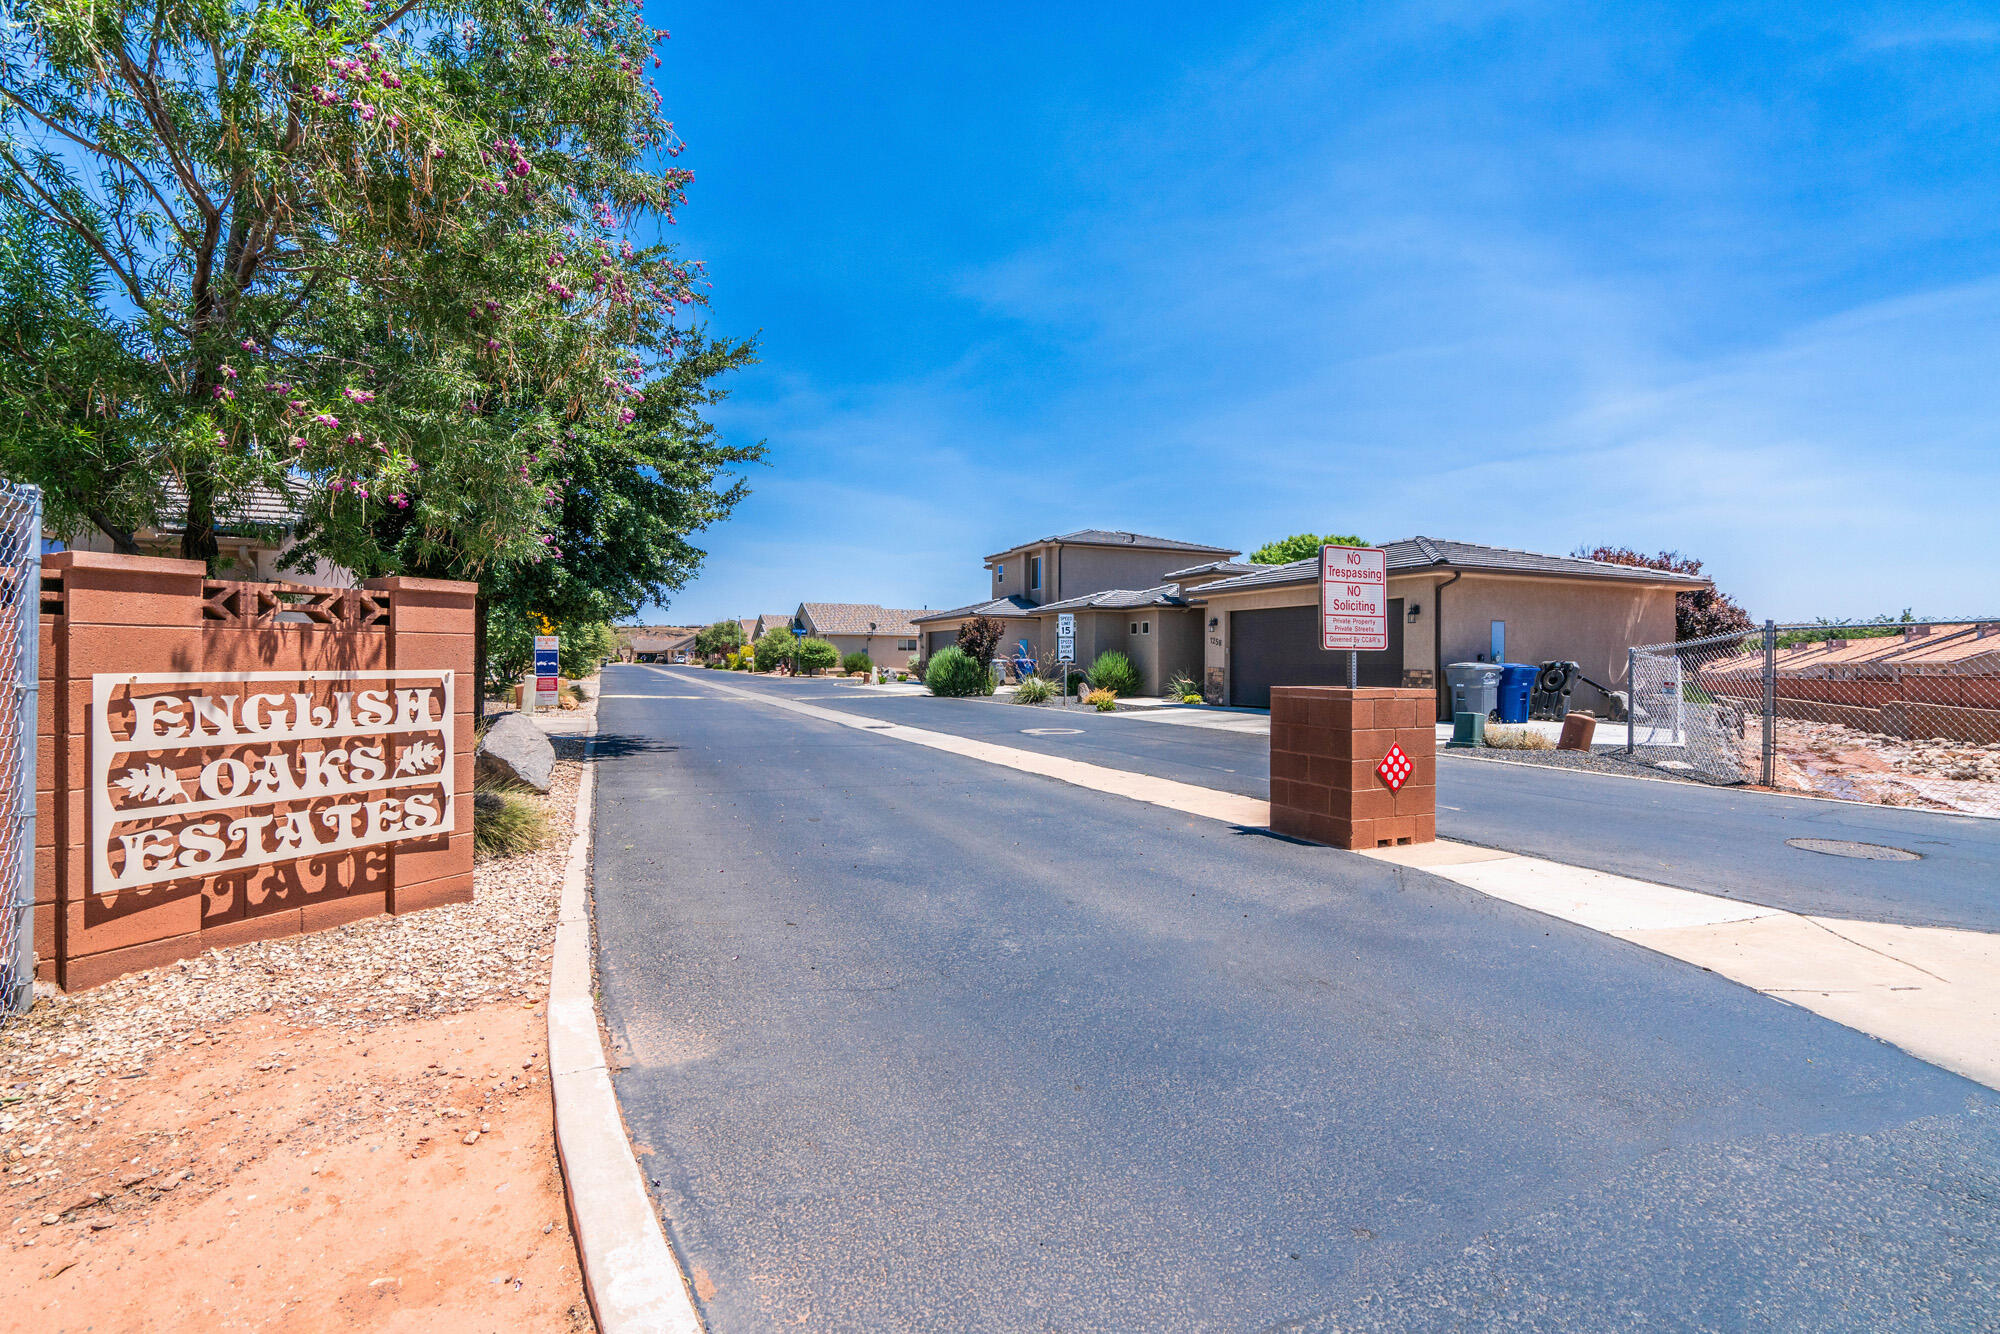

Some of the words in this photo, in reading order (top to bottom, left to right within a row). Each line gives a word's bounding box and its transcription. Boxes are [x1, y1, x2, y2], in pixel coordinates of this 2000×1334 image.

[1347, 553, 1361, 565] NO
[1328, 565, 1382, 581] Trespassing
[1347, 585, 1361, 597] NO
[1333, 599, 1376, 614] Soliciting
[1061, 626, 1071, 634] 15
[1329, 635, 1352, 643] Governed
[129, 688, 433, 742] ENGLISH
[200, 746, 387, 800] OAKS
[119, 793, 439, 879] ESTATES
